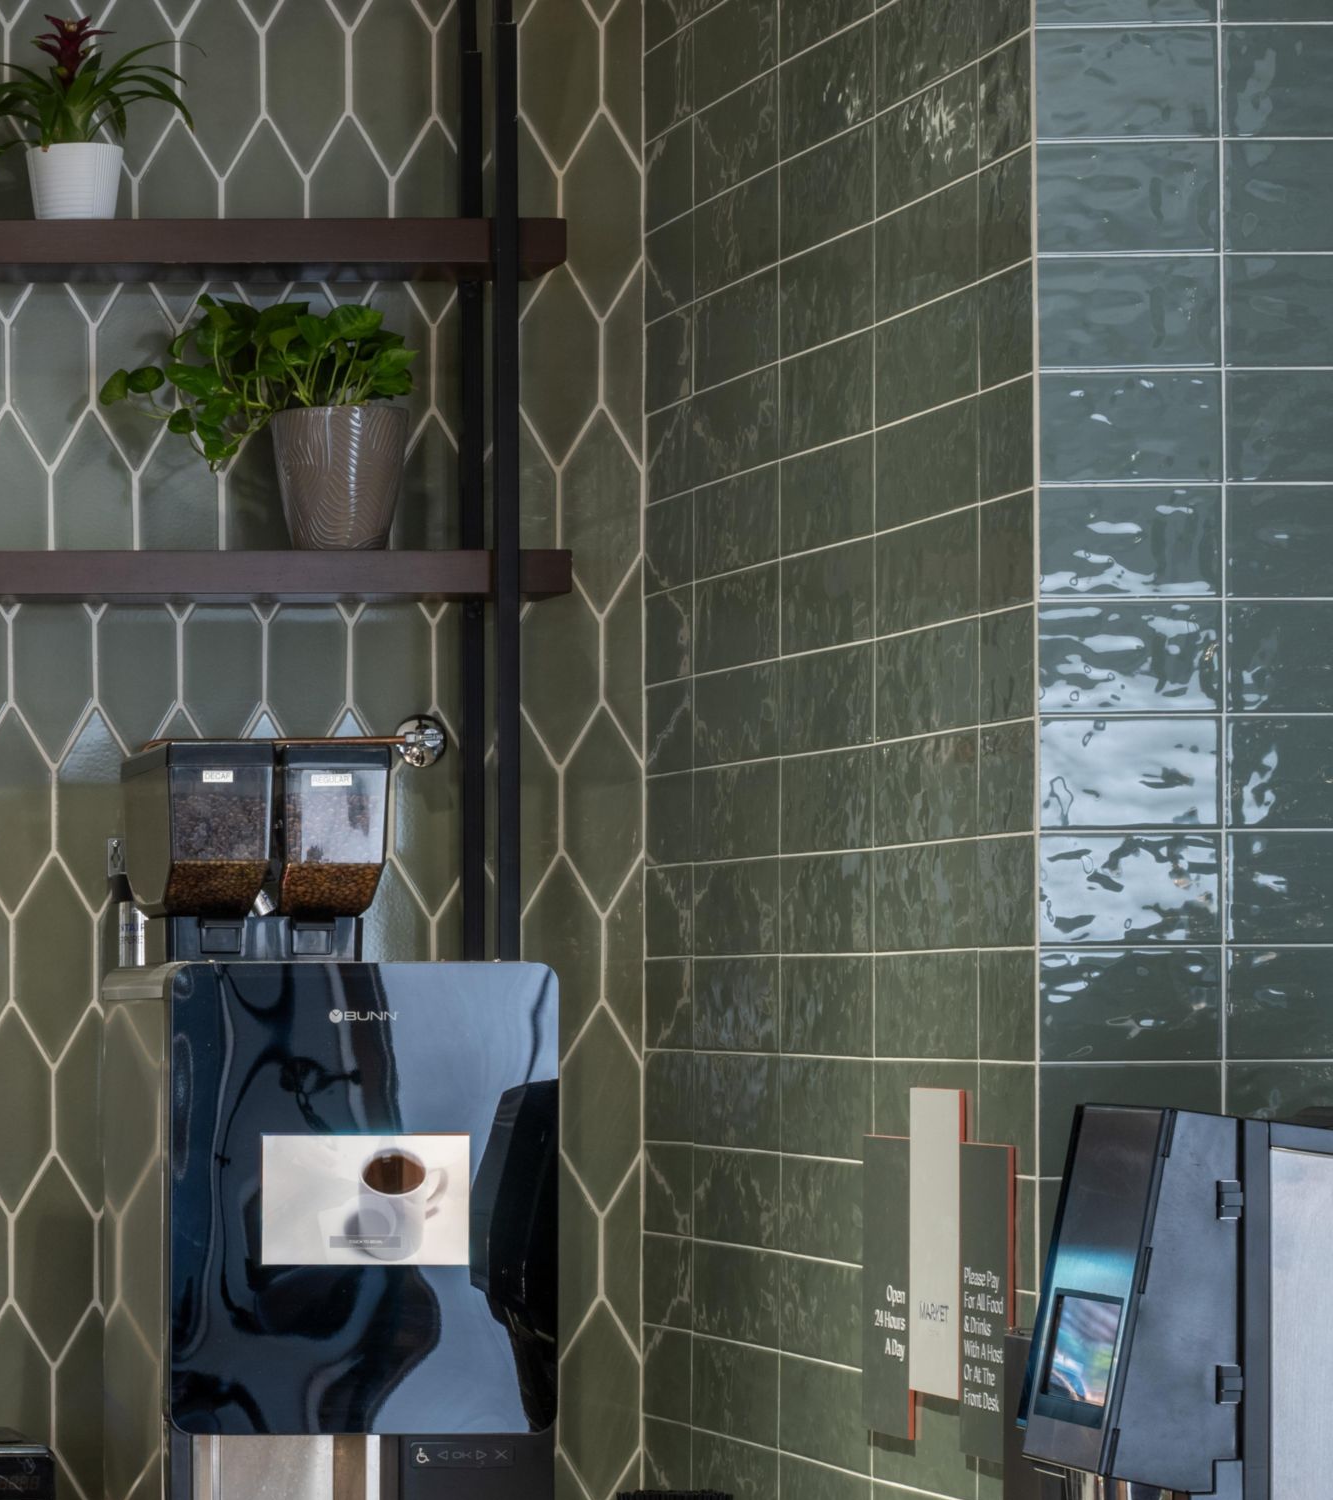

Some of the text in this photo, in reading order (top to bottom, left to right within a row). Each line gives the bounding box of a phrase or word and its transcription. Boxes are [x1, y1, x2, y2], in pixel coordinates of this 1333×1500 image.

[205, 772, 230, 780] DECAF
[344, 1011, 395, 1021] BUNN
[964, 1267, 1000, 1293] Please Pay
[886, 1284, 905, 1307] Open
[964, 1292, 1004, 1314] For All Food
[874, 1309, 906, 1331] 24 Hours
[919, 1302, 949, 1322] MARKET
[964, 1316, 991, 1336] & Drinks
[885, 1338, 905, 1362] A Day
[964, 1340, 1004, 1364] With A Host
[964, 1364, 995, 1386] Or At The
[964, 1388, 1000, 1412] Front Desk
